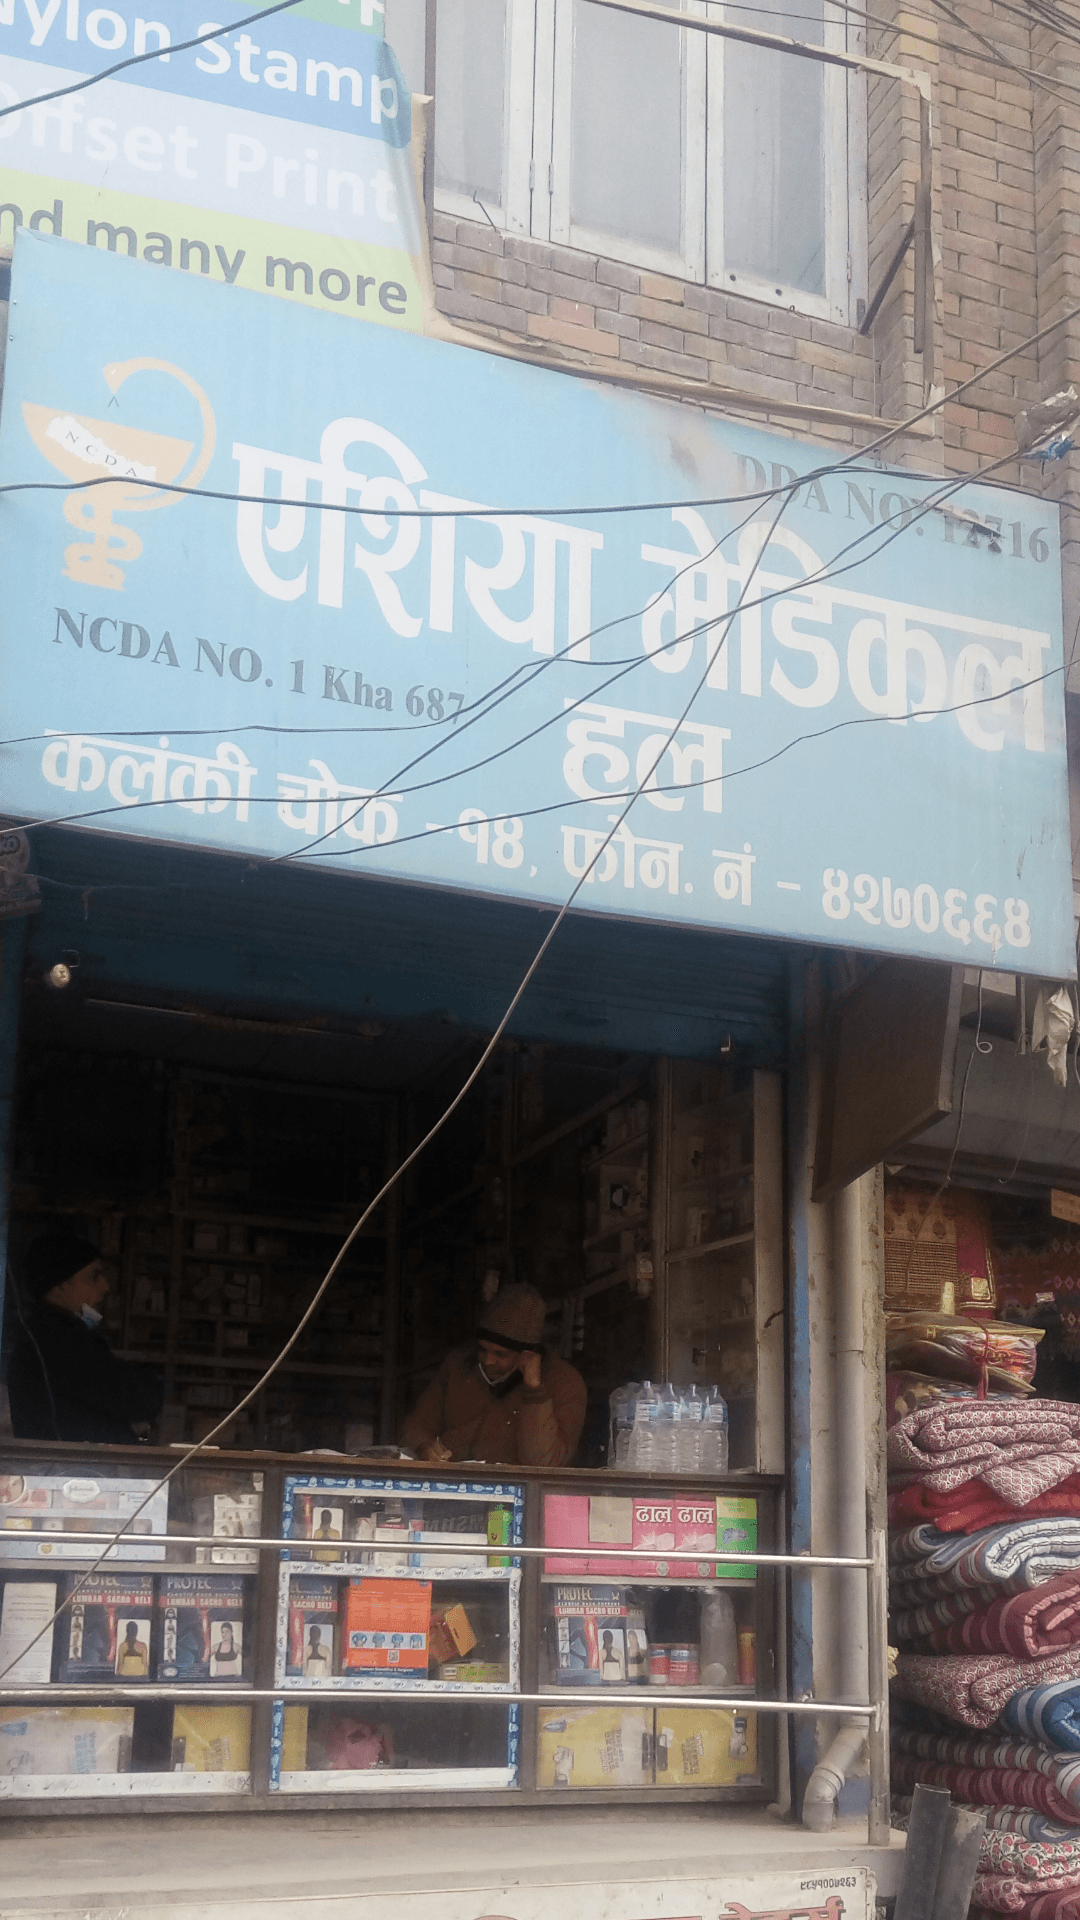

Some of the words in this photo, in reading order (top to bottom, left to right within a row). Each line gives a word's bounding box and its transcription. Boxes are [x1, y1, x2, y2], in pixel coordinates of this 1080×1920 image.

[195, 22, 399, 125] Stamp
[225, 132, 398, 223] Print
[86, 218, 247, 285] many
[264, 254, 408, 315] more
[66, 431, 138, 477] NCDA
[733, 451, 833, 515] DDA
[843, 479, 925, 536] NO.
[232, 416, 604, 662] एशिया
[641, 506, 1051, 752] मेडिकल
[52, 606, 181, 667] NCDA
[194, 636, 274, 687] NO.
[290, 659, 306, 694] 1
[322, 664, 394, 712] Kha
[405, 684, 466, 724] 687
[563, 697, 732, 813] हल
[42, 729, 258, 822] कलंकी
[277, 759, 403, 844] चोक
[560, 814, 695, 895] फोन.
[713, 842, 757, 906] नं
[822, 868, 1032, 948] ४२७०६६४
[635, 1506, 673, 1523] ढाल
[677, 1507, 715, 1524] ढाल
[134, 1596, 152, 1604] BELT
[166, 1576, 211, 1589] PROTEC
[557, 1587, 594, 1600] PROTEC
